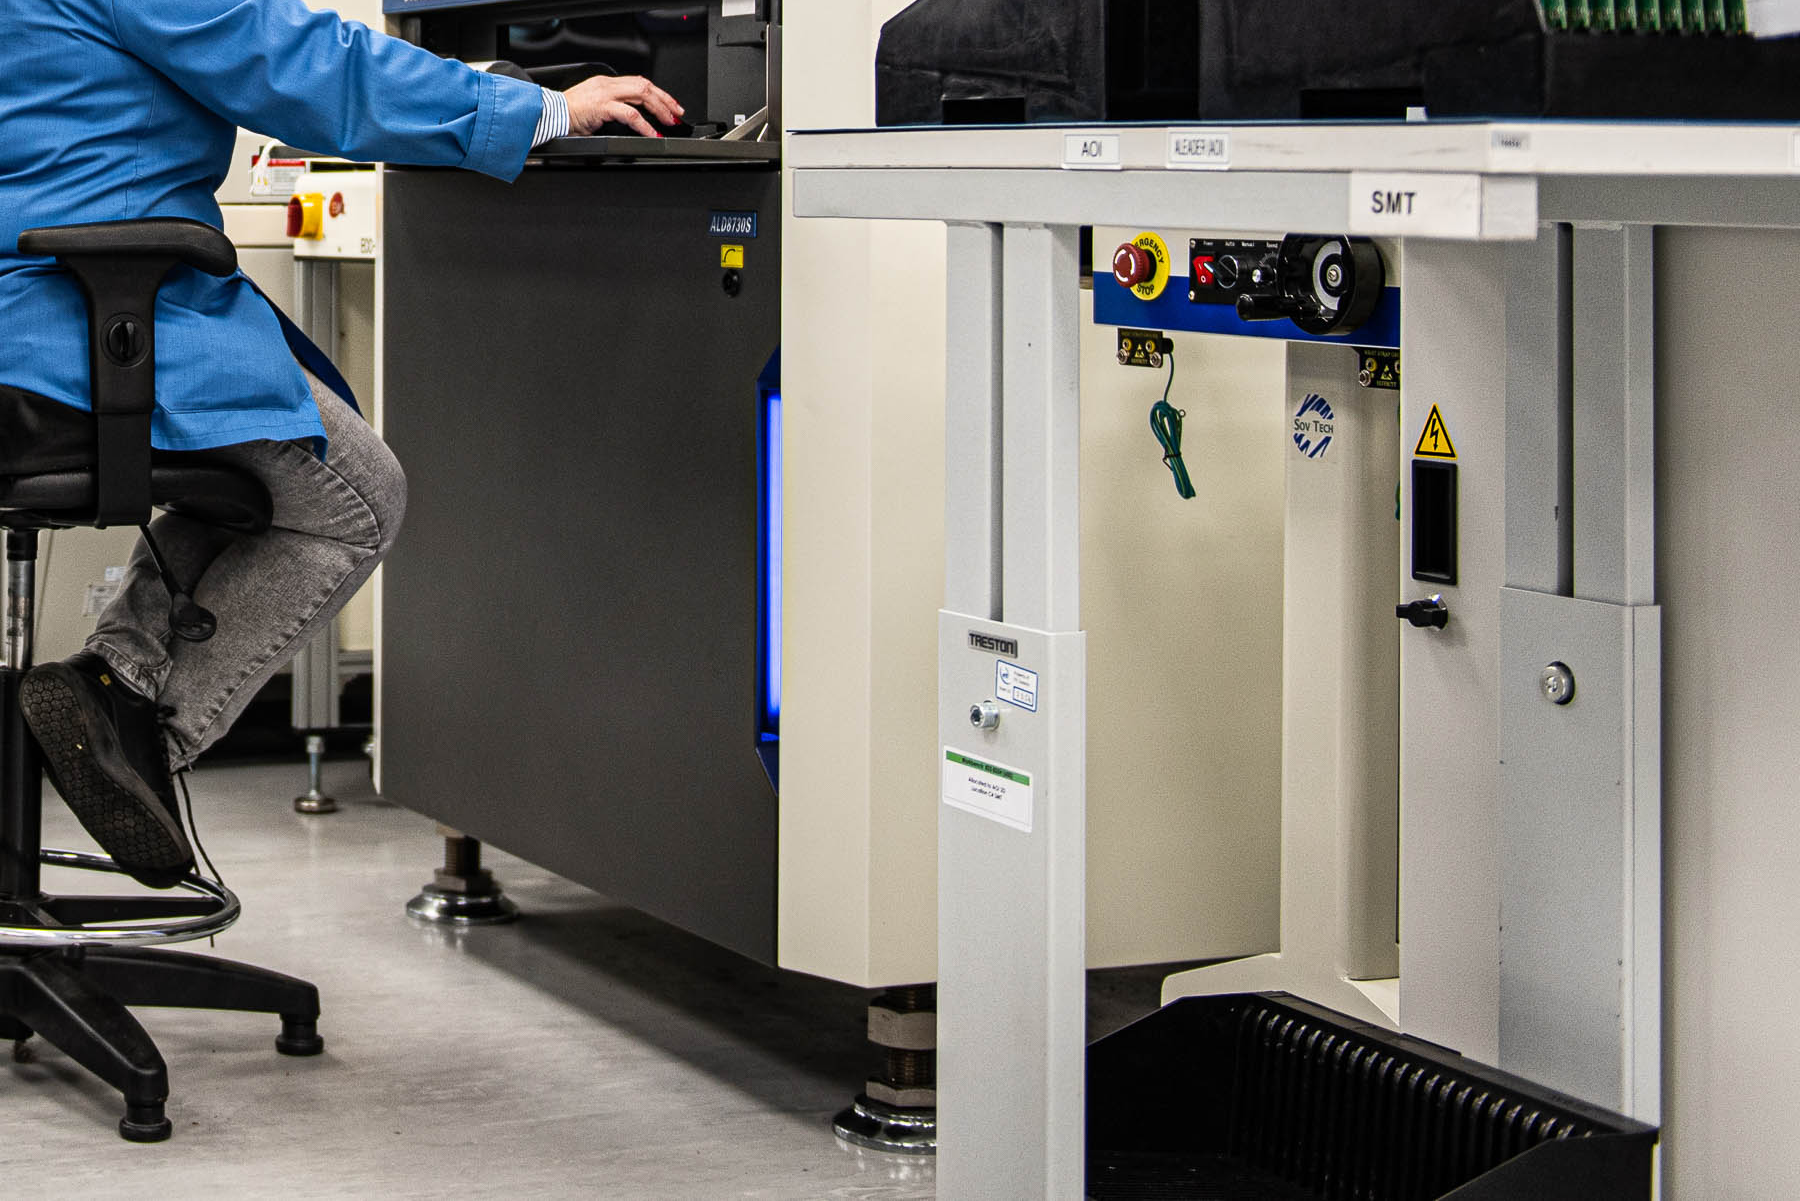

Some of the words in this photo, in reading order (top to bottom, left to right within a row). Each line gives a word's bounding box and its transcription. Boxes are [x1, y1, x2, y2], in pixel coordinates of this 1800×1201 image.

[1081, 140, 1103, 157] AOI
[1371, 190, 1416, 214] SMT
[710, 216, 752, 233] ALD8730S
[1136, 284, 1155, 296] STOP
[969, 633, 1014, 655] TRESTON
